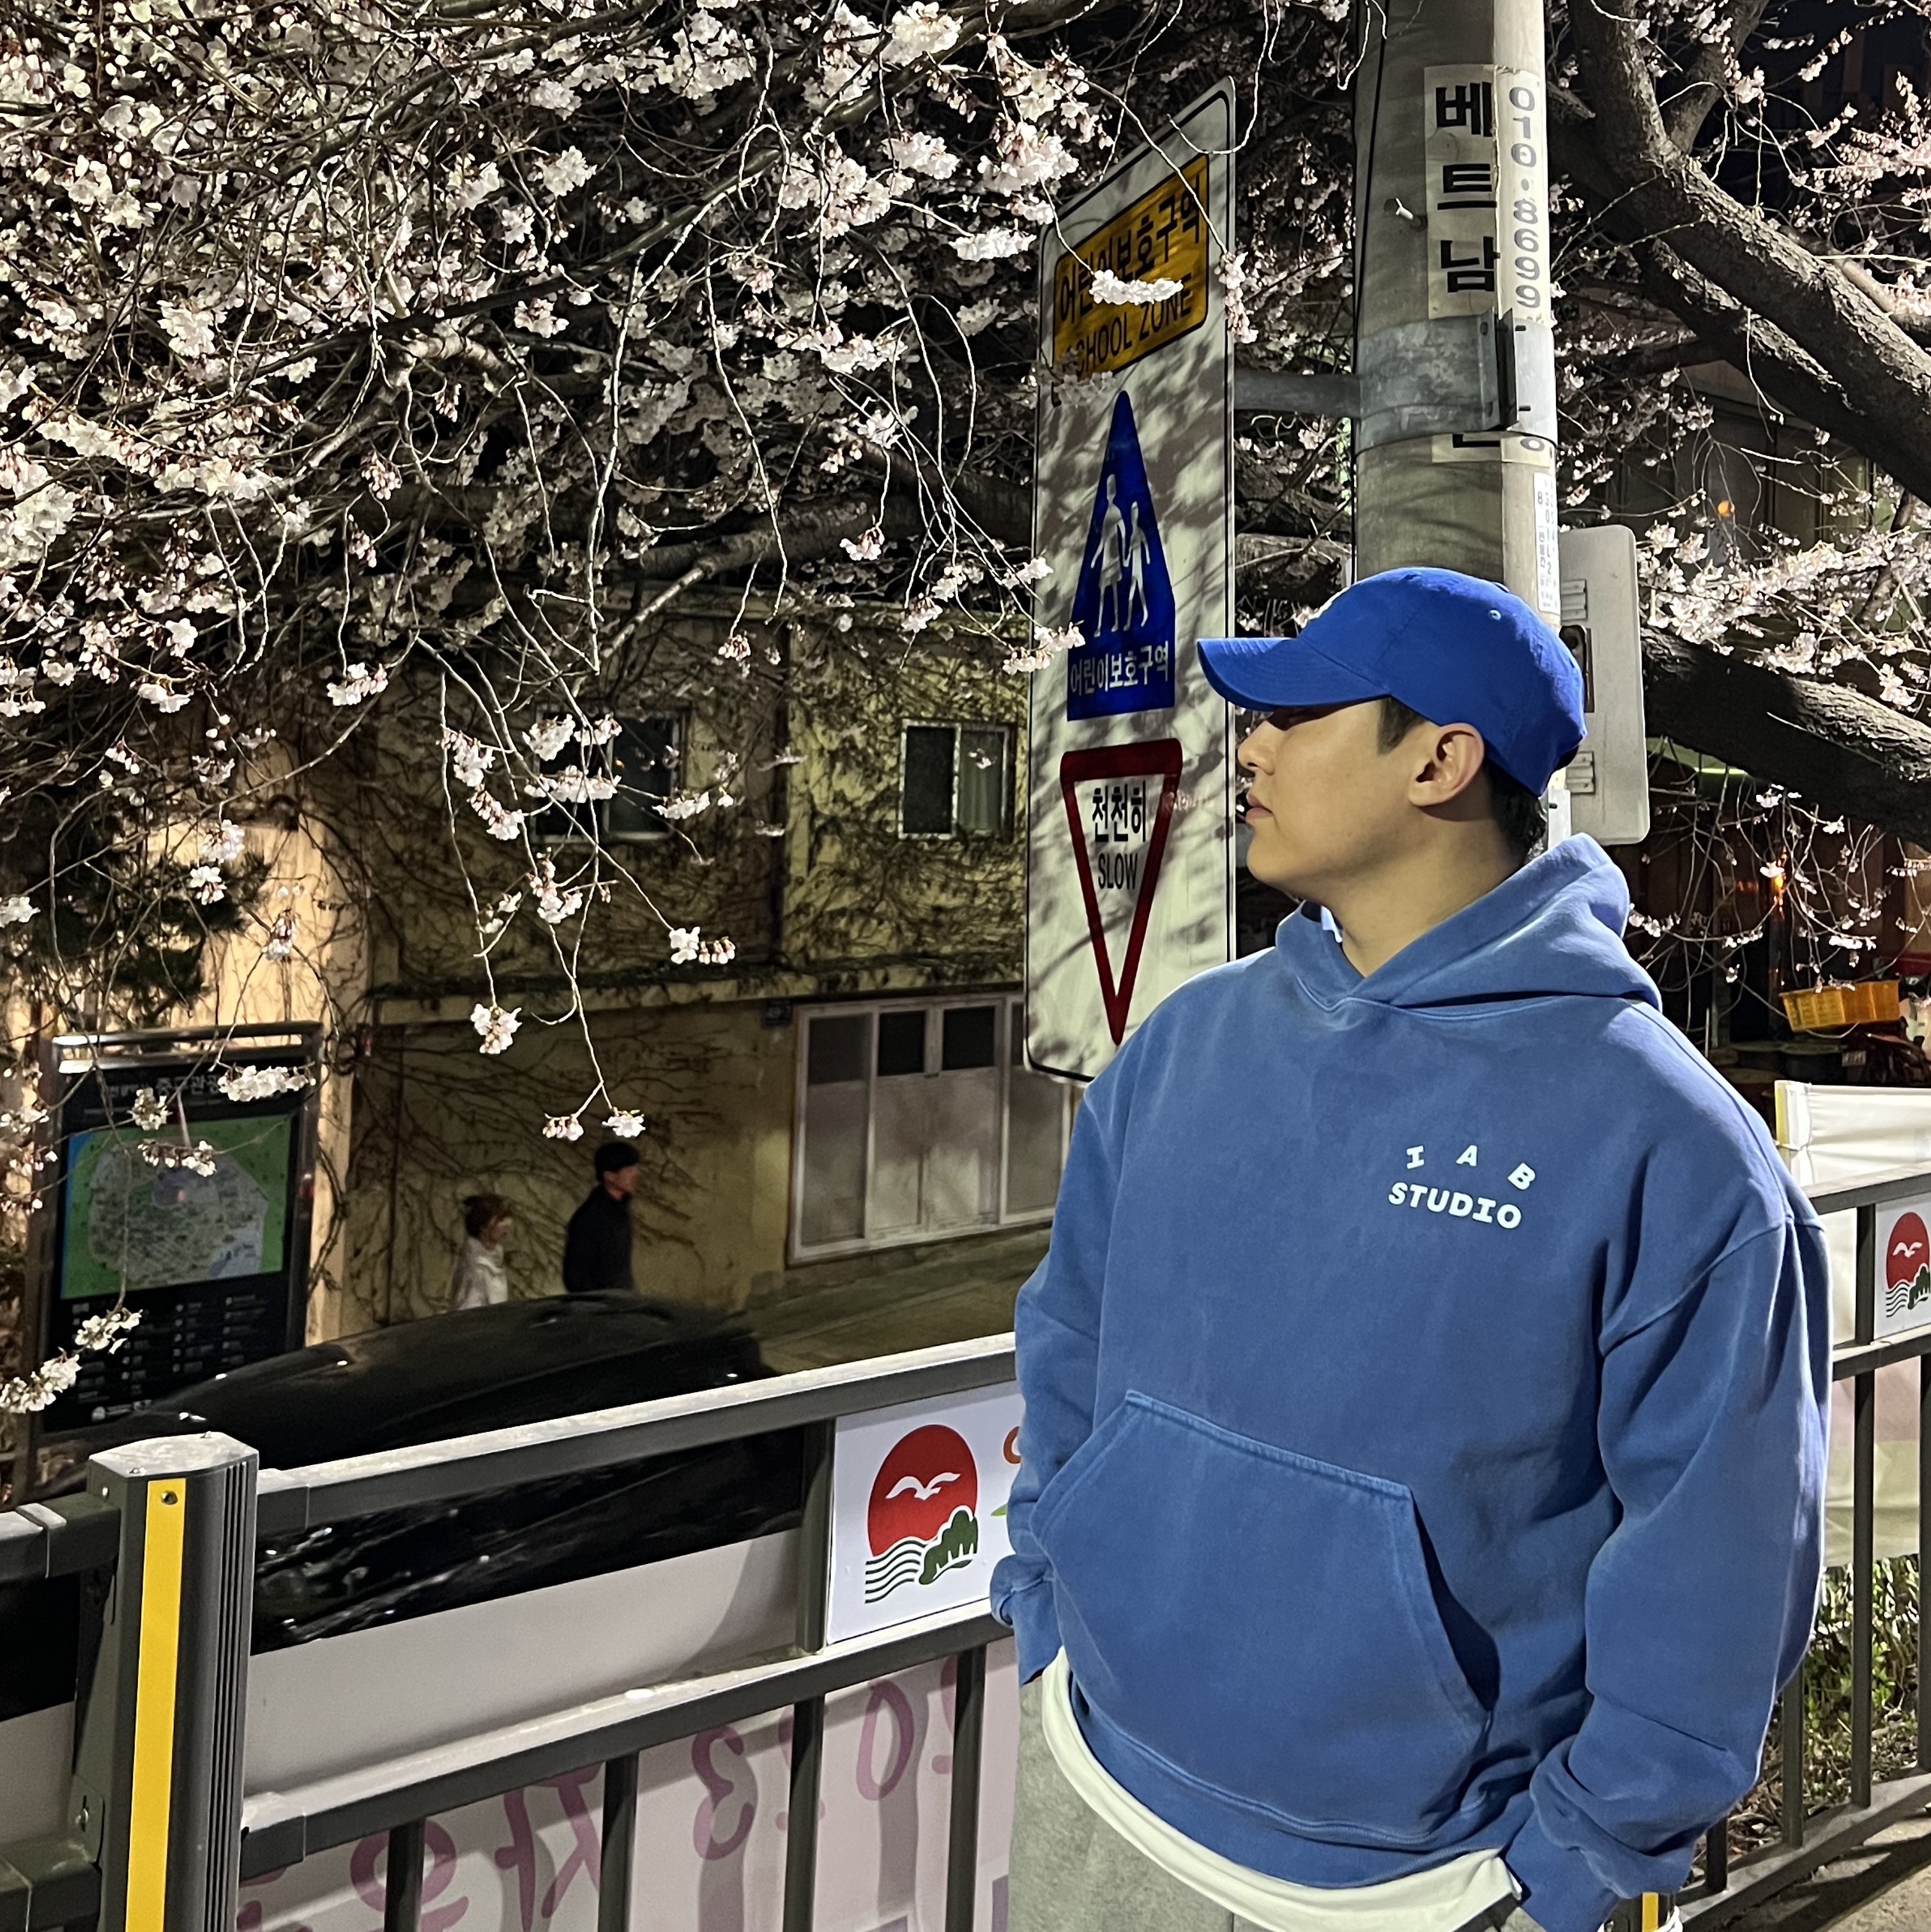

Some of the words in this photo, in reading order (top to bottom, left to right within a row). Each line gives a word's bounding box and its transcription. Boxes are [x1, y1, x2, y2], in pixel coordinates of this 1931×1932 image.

[1436, 81, 1501, 293] 베트남
[1065, 311, 1133, 381] CHOOL
[1139, 272, 1191, 341] ZONE
[1070, 640, 1169, 696] 어린이보호구역
[1092, 779, 1147, 843] 천천히
[1097, 852, 1138, 890] SLOW
[1388, 1181, 1522, 1229] STUDIO
